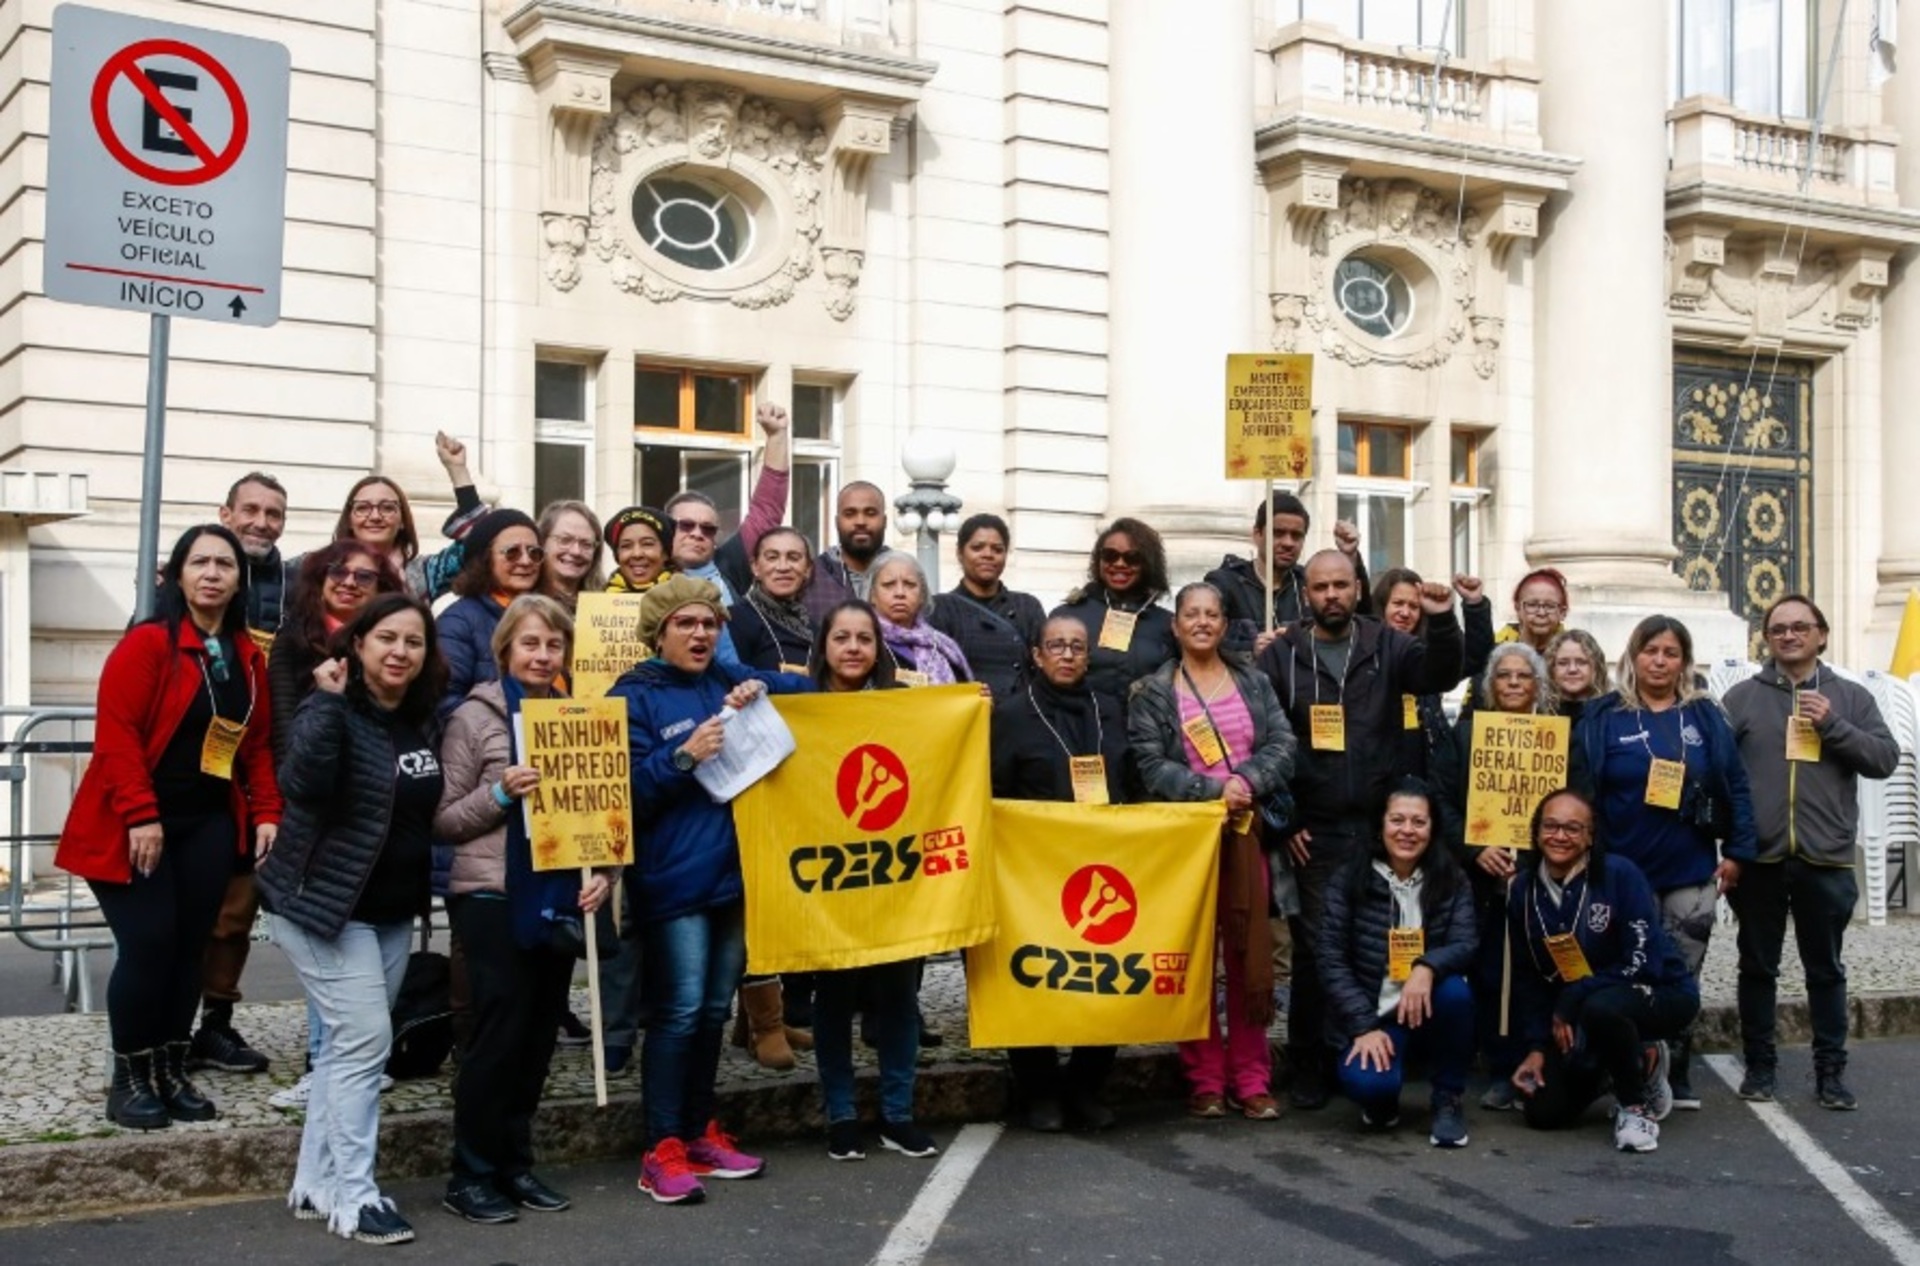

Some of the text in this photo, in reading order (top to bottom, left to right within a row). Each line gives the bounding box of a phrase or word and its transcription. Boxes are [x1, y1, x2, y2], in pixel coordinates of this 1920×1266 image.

[122, 190, 213, 219] EXCETO
[117, 216, 215, 246] VEÍCULO
[120, 243, 207, 270] OFICIAL
[120, 280, 205, 311] INÍCIO
[591, 614, 637, 628] VALORIZ
[600, 629, 636, 643] SALAR
[533, 720, 621, 749] NENHUM
[1485, 727, 1557, 751] REVISÃO
[530, 751, 627, 781] EMPREGO
[1473, 748, 1565, 774] GERAL DOS
[532, 783, 629, 815] A MENOS!
[789, 834, 922, 893] CPERS
[1010, 944, 1152, 995] CPERS
